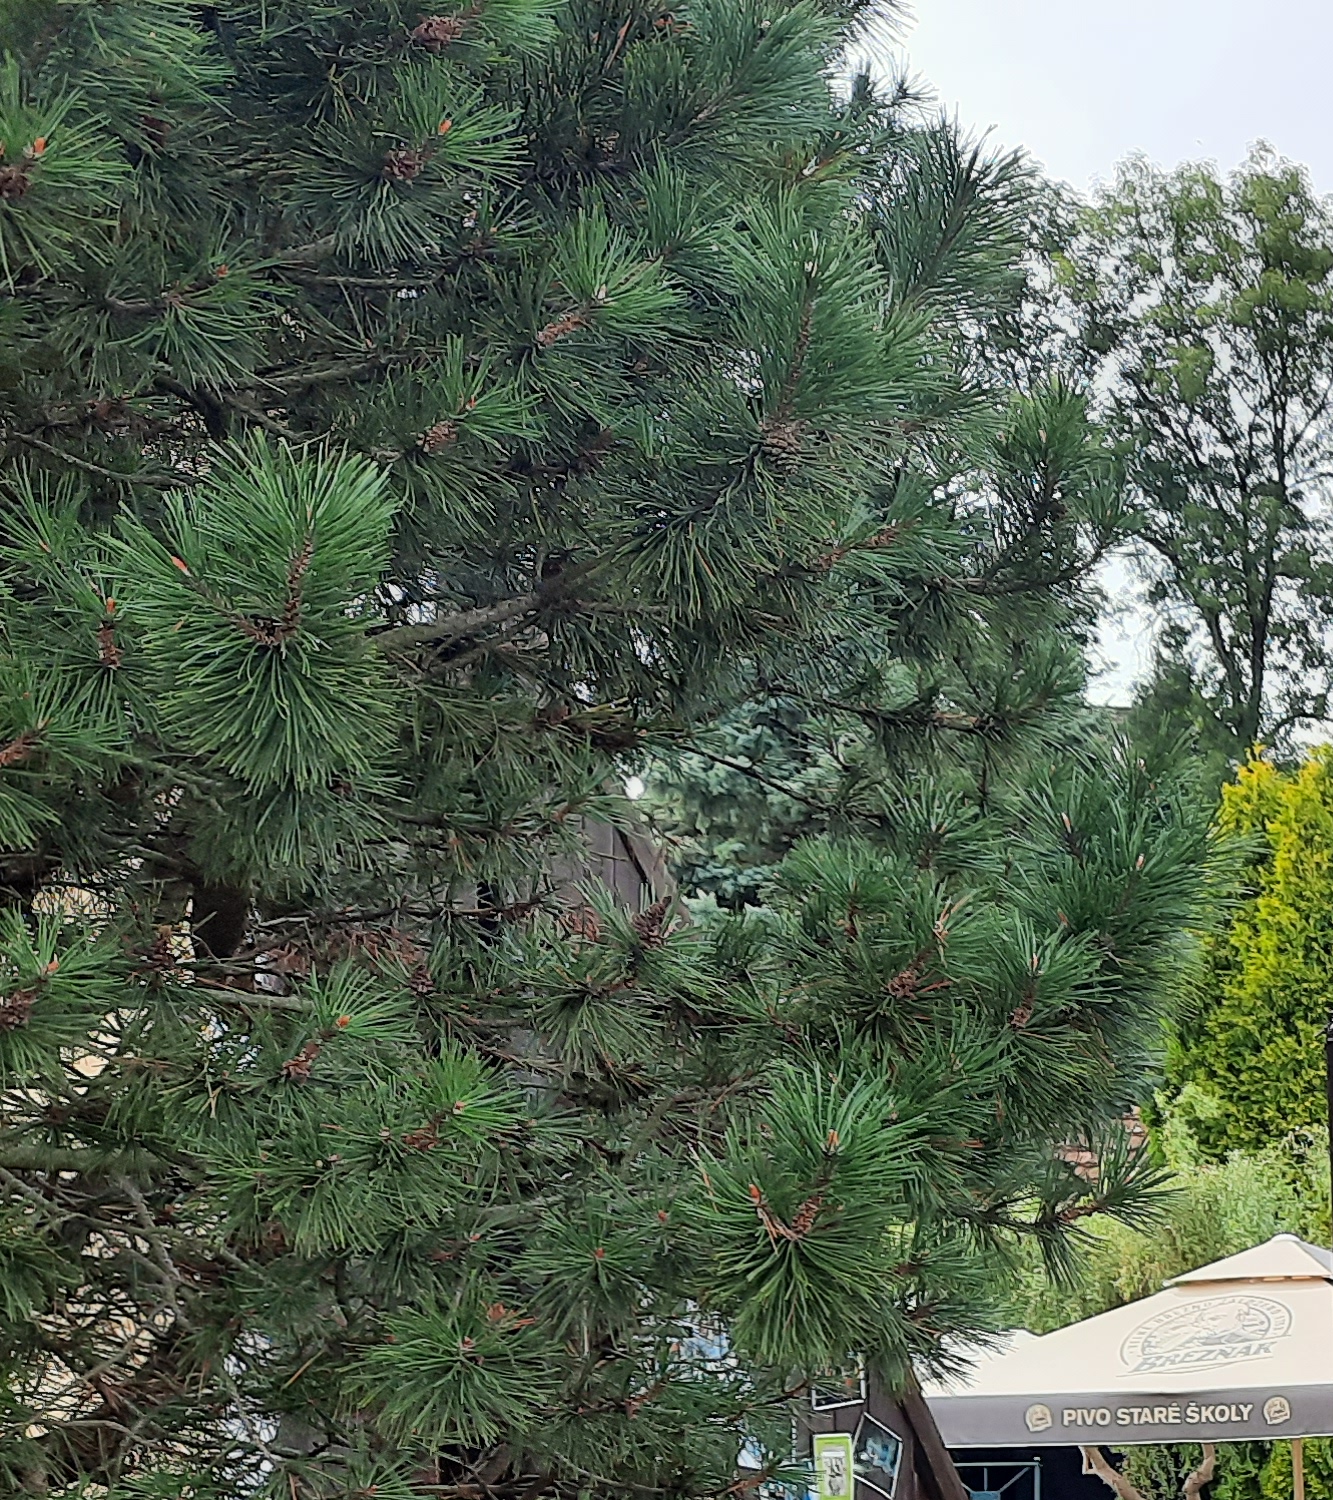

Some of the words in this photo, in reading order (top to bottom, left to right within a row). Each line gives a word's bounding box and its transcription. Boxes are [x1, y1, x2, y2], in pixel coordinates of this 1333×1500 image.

[1062, 1408, 1111, 1426] PIVO
[1116, 1402, 1181, 1424] STARÉ
[1185, 1402, 1253, 1423] ŠKOLY
